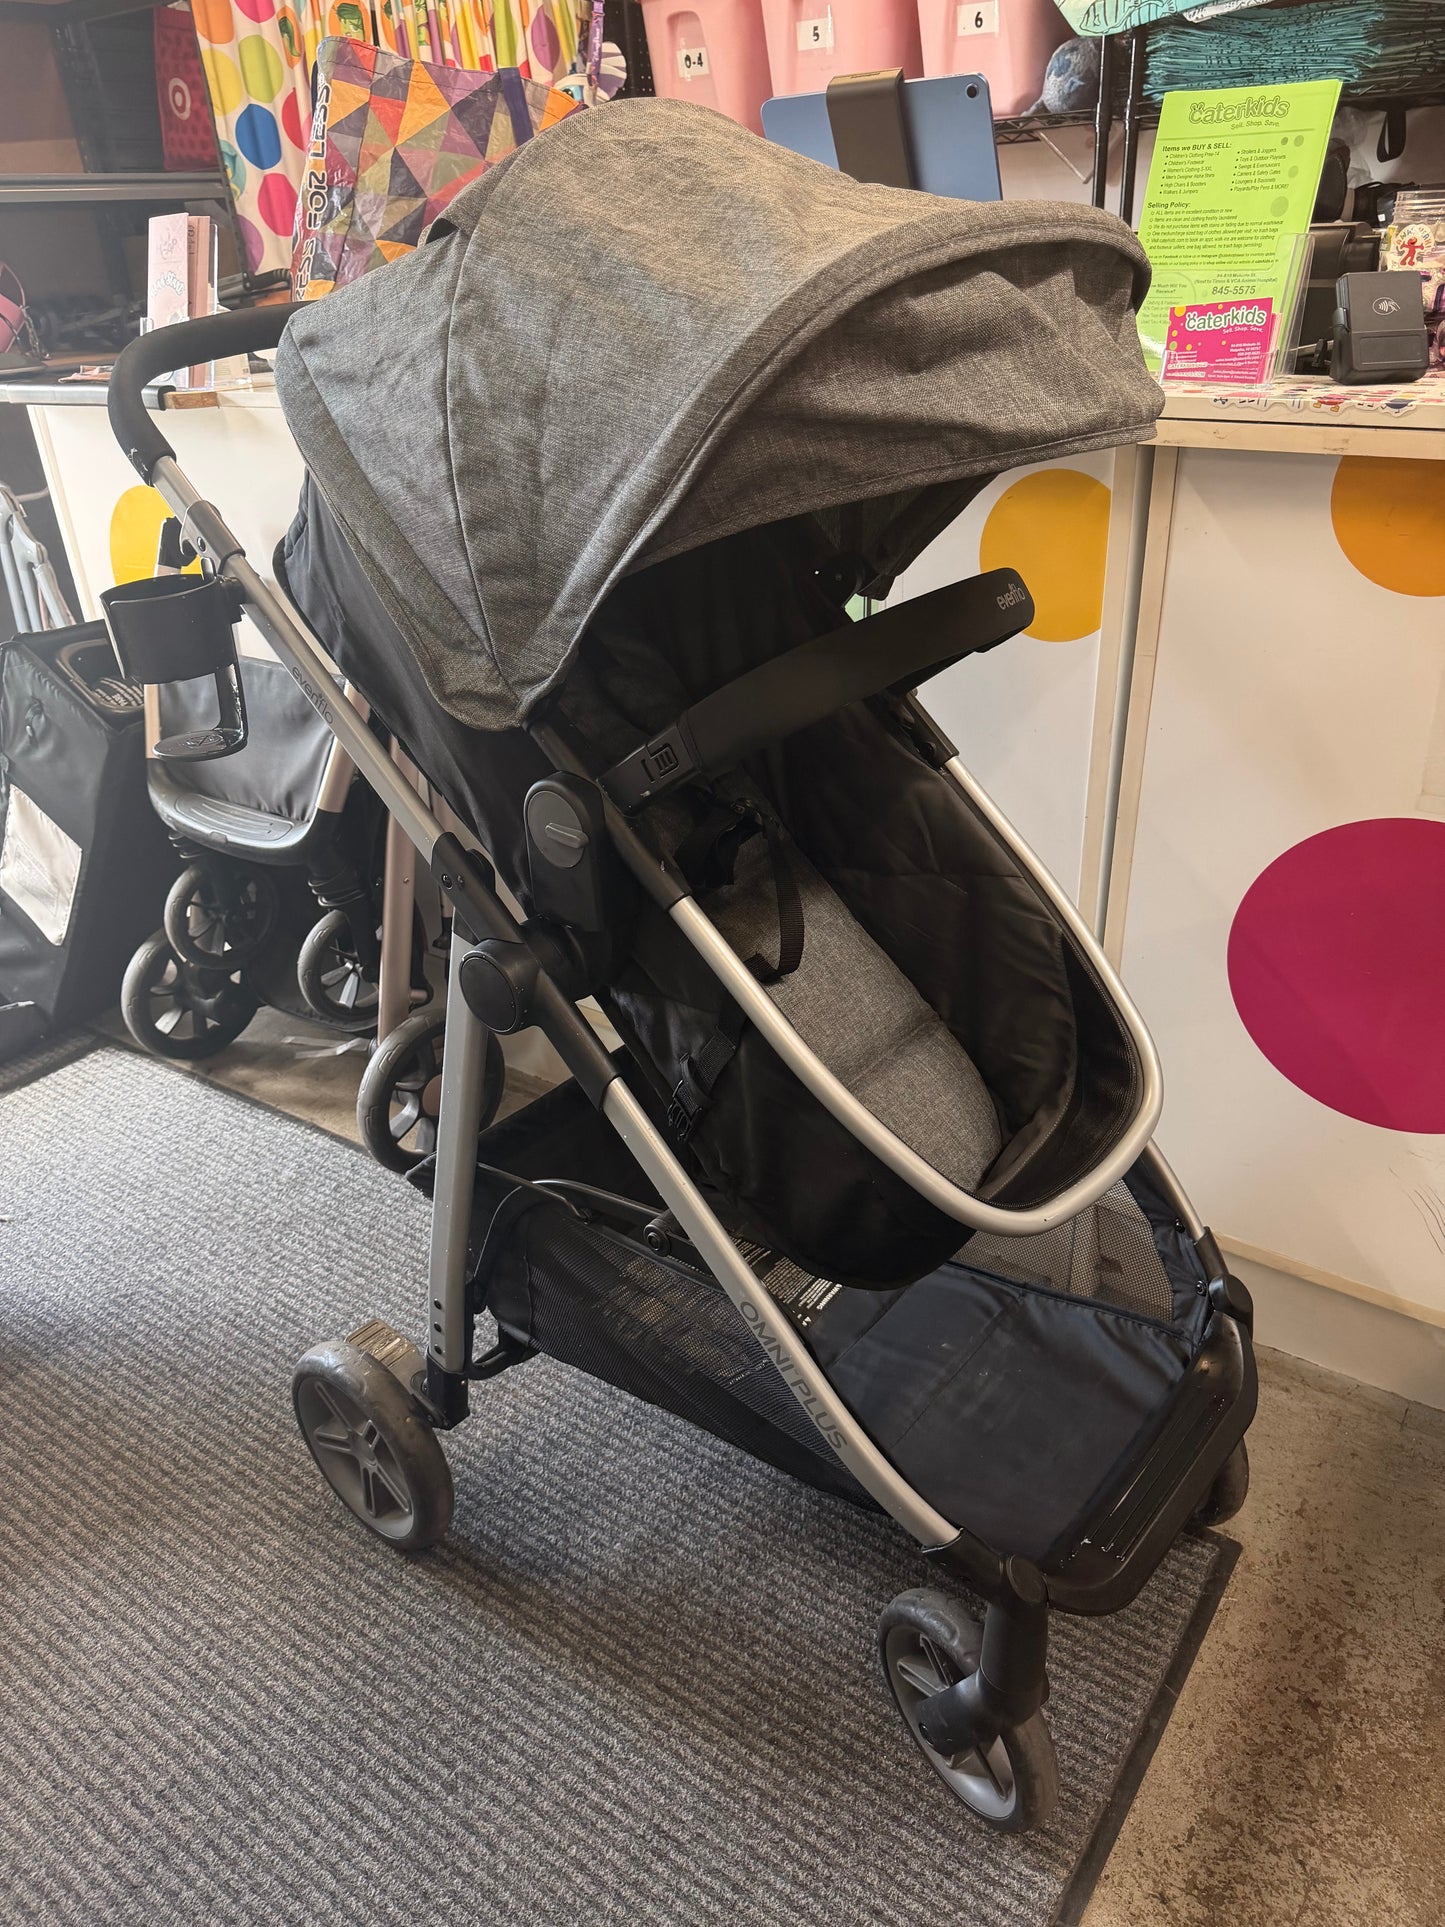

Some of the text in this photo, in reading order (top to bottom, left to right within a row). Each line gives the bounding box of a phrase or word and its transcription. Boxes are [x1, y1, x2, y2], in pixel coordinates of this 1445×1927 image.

[974, 11, 983, 28] 6
[812, 26, 820, 42] 5
[684, 52, 704, 69] 0-4
[310, 84, 331, 158] LESS
[307, 171, 328, 230] FOR
[1212, 286, 1256, 295] 845-5575
[997, 583, 1026, 610] evenflo
[292, 666, 334, 724] evenflo
[739, 1301, 794, 1373] OMNI
[791, 1377, 848, 1450] PLUS
